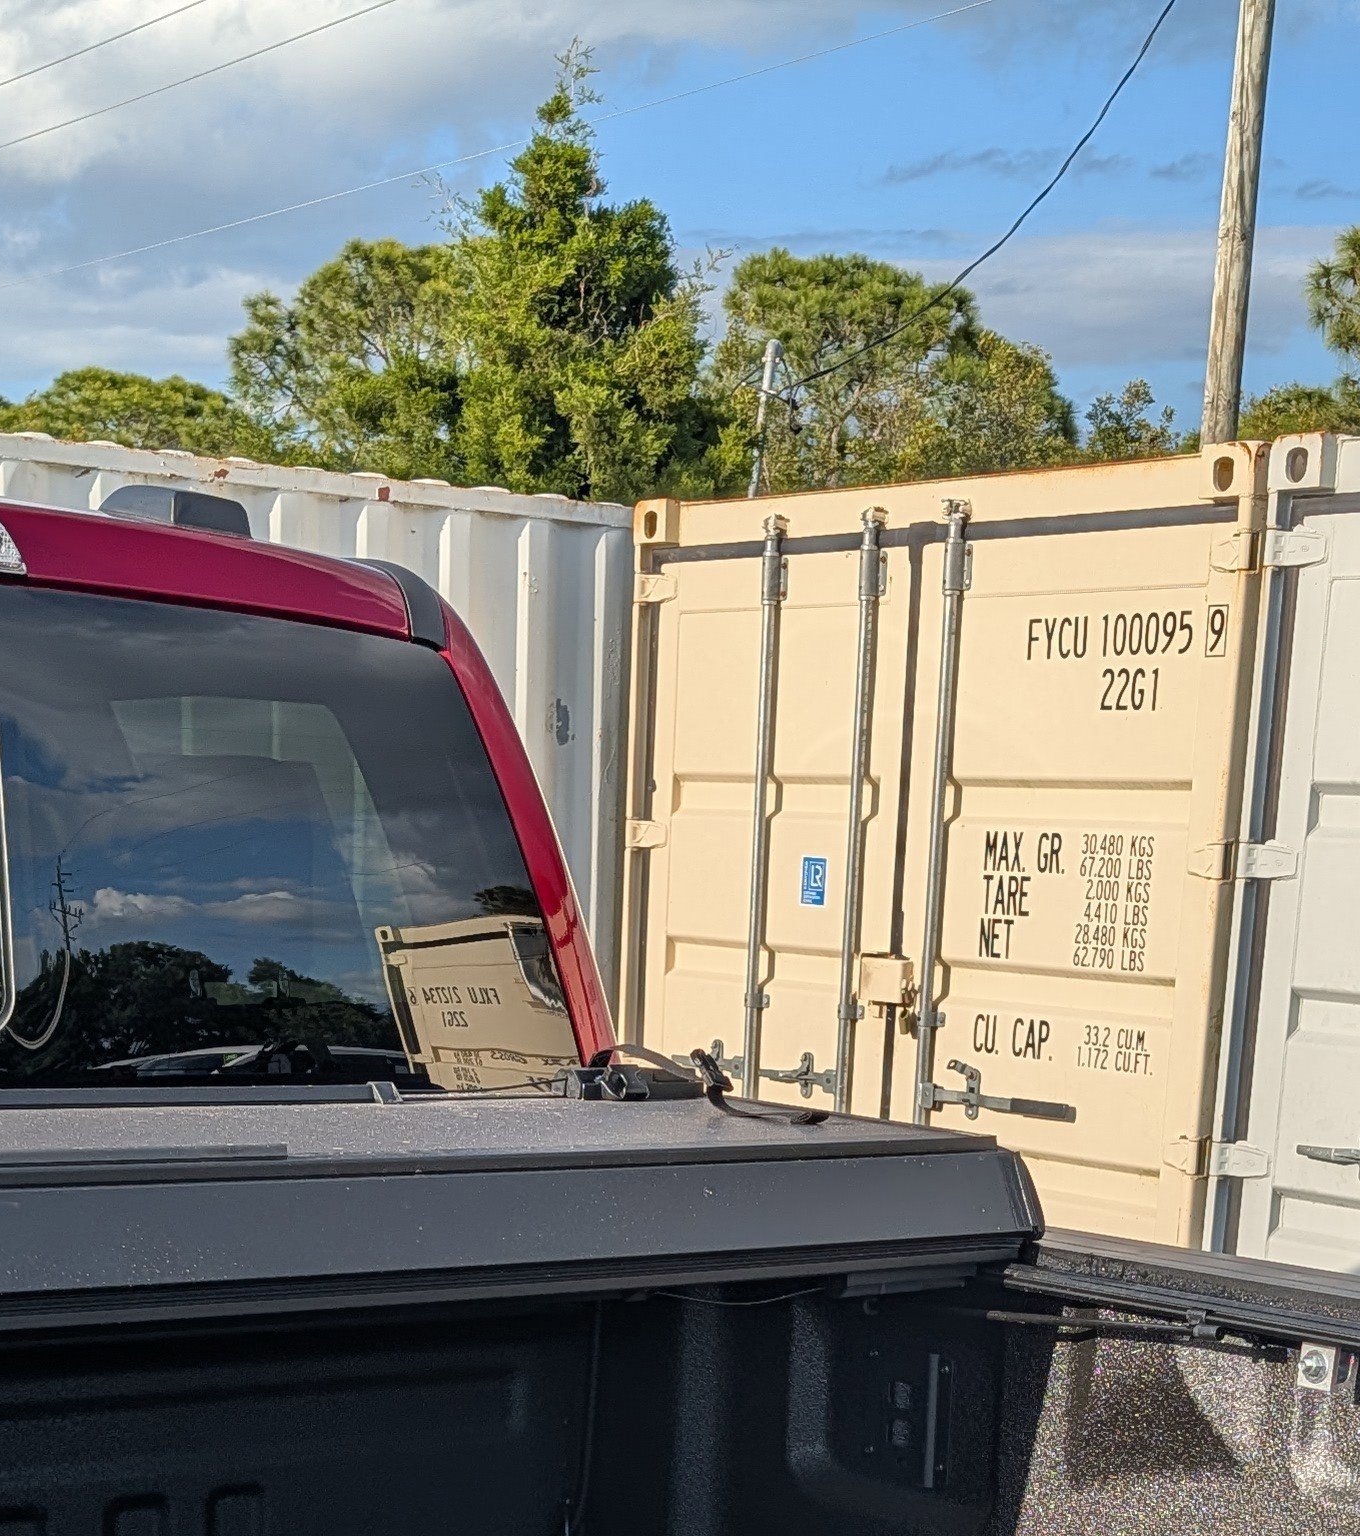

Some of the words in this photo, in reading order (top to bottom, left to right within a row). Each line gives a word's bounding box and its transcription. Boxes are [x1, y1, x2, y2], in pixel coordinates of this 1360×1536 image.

[1027, 616, 1088, 660] FYCU
[1103, 611, 1193, 657] 100095
[1209, 609, 1225, 652] 9
[1100, 668, 1159, 711] 22G1
[984, 831, 1025, 872] MAX.
[1037, 833, 1065, 874] GR.
[1130, 836, 1155, 857] KGS
[1128, 859, 1152, 880] LBS
[983, 875, 1031, 916] TARE
[1126, 882, 1151, 903] KGS
[1124, 905, 1148, 926] LBS
[979, 918, 1014, 959] NET
[1122, 927, 1147, 949] KGS
[1120, 950, 1145, 971] LBS
[973, 1014, 999, 1055] CU.
[1012, 1018, 1052, 1061] CAP.
[1084, 1025, 1111, 1047] 33.2
[1117, 1029, 1147, 1052] CU.M.
[1115, 1051, 1152, 1076] CU.FT.
